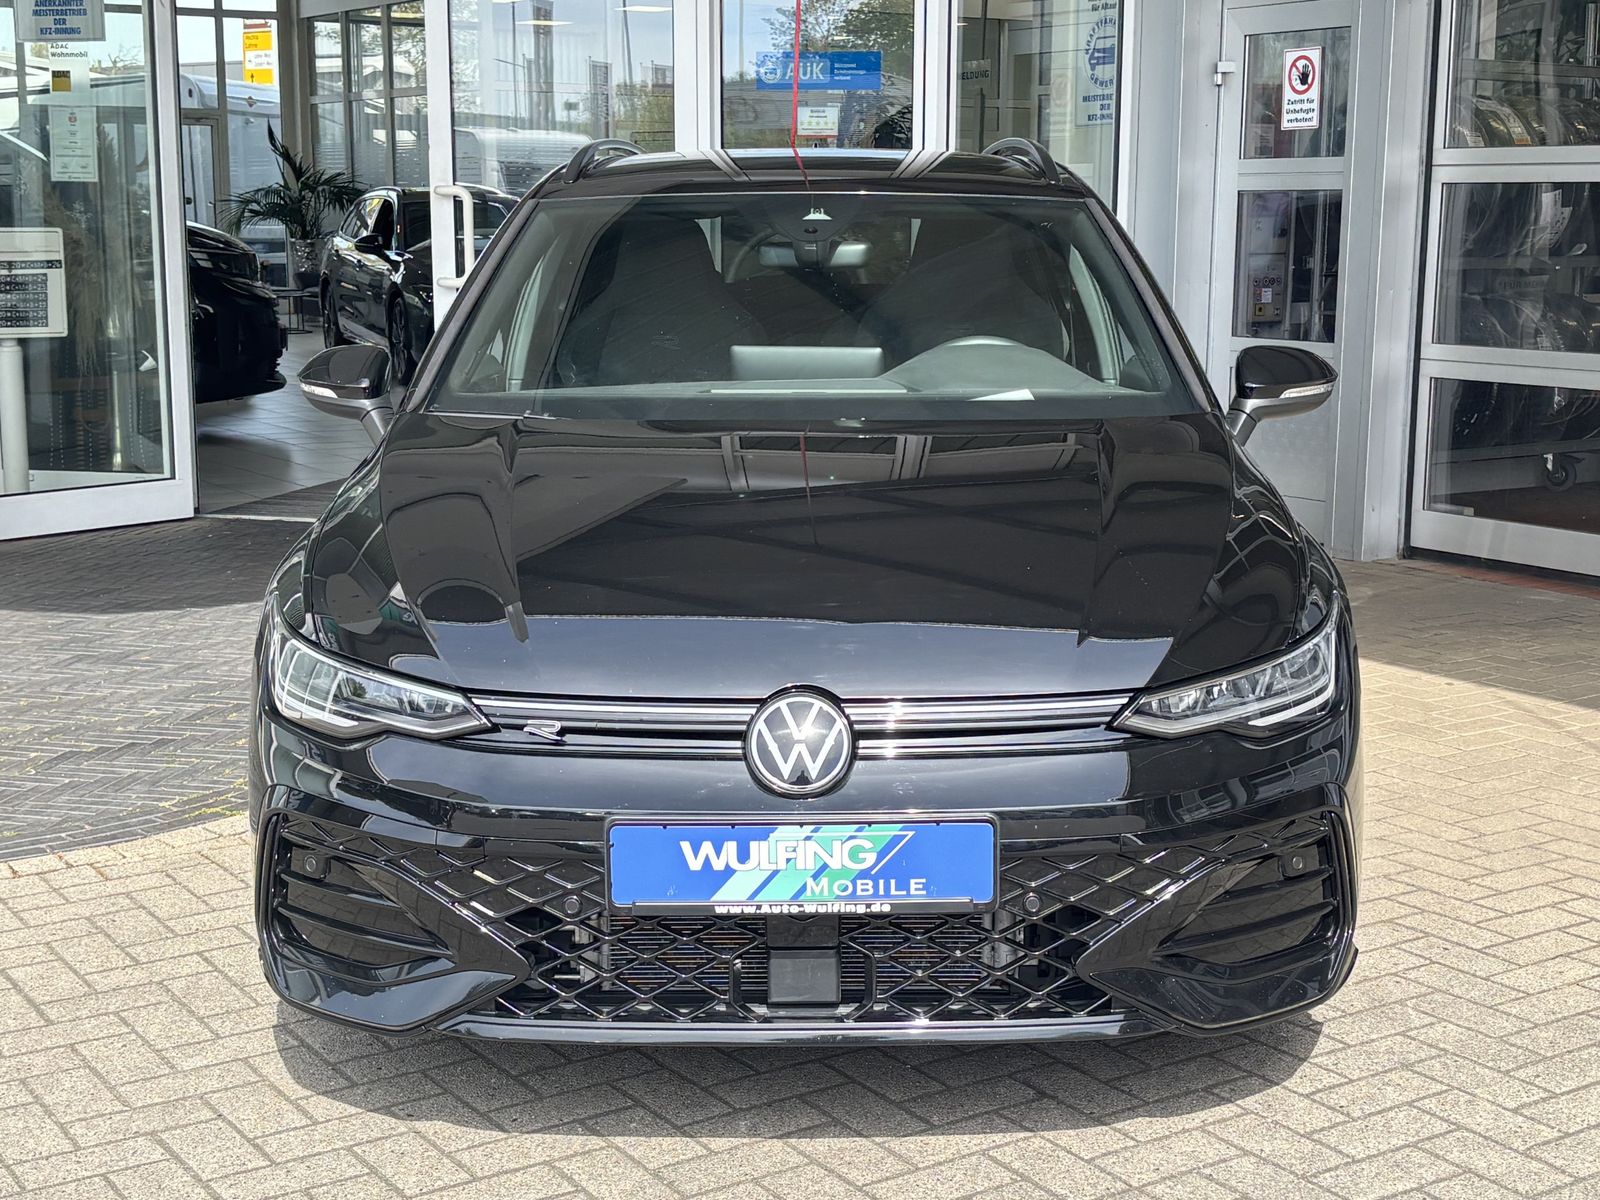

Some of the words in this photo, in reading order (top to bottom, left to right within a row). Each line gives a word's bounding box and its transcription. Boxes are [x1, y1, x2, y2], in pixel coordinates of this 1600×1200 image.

[32, 8, 87, 17] MEISTERBETRIEB
[53, 18, 67, 26] DER
[40, 27, 81, 36] KFZ-INNUNG
[960, 70, 990, 80] ELDUNG
[1099, 103, 1111, 111] DER
[1285, 107, 1315, 115] Unbefugte
[1287, 116, 1314, 124] verboten!
[679, 838, 877, 872] WULFING
[805, 878, 927, 897] MOBILE
[714, 902, 892, 915] www.Auto-Wulfing.de
